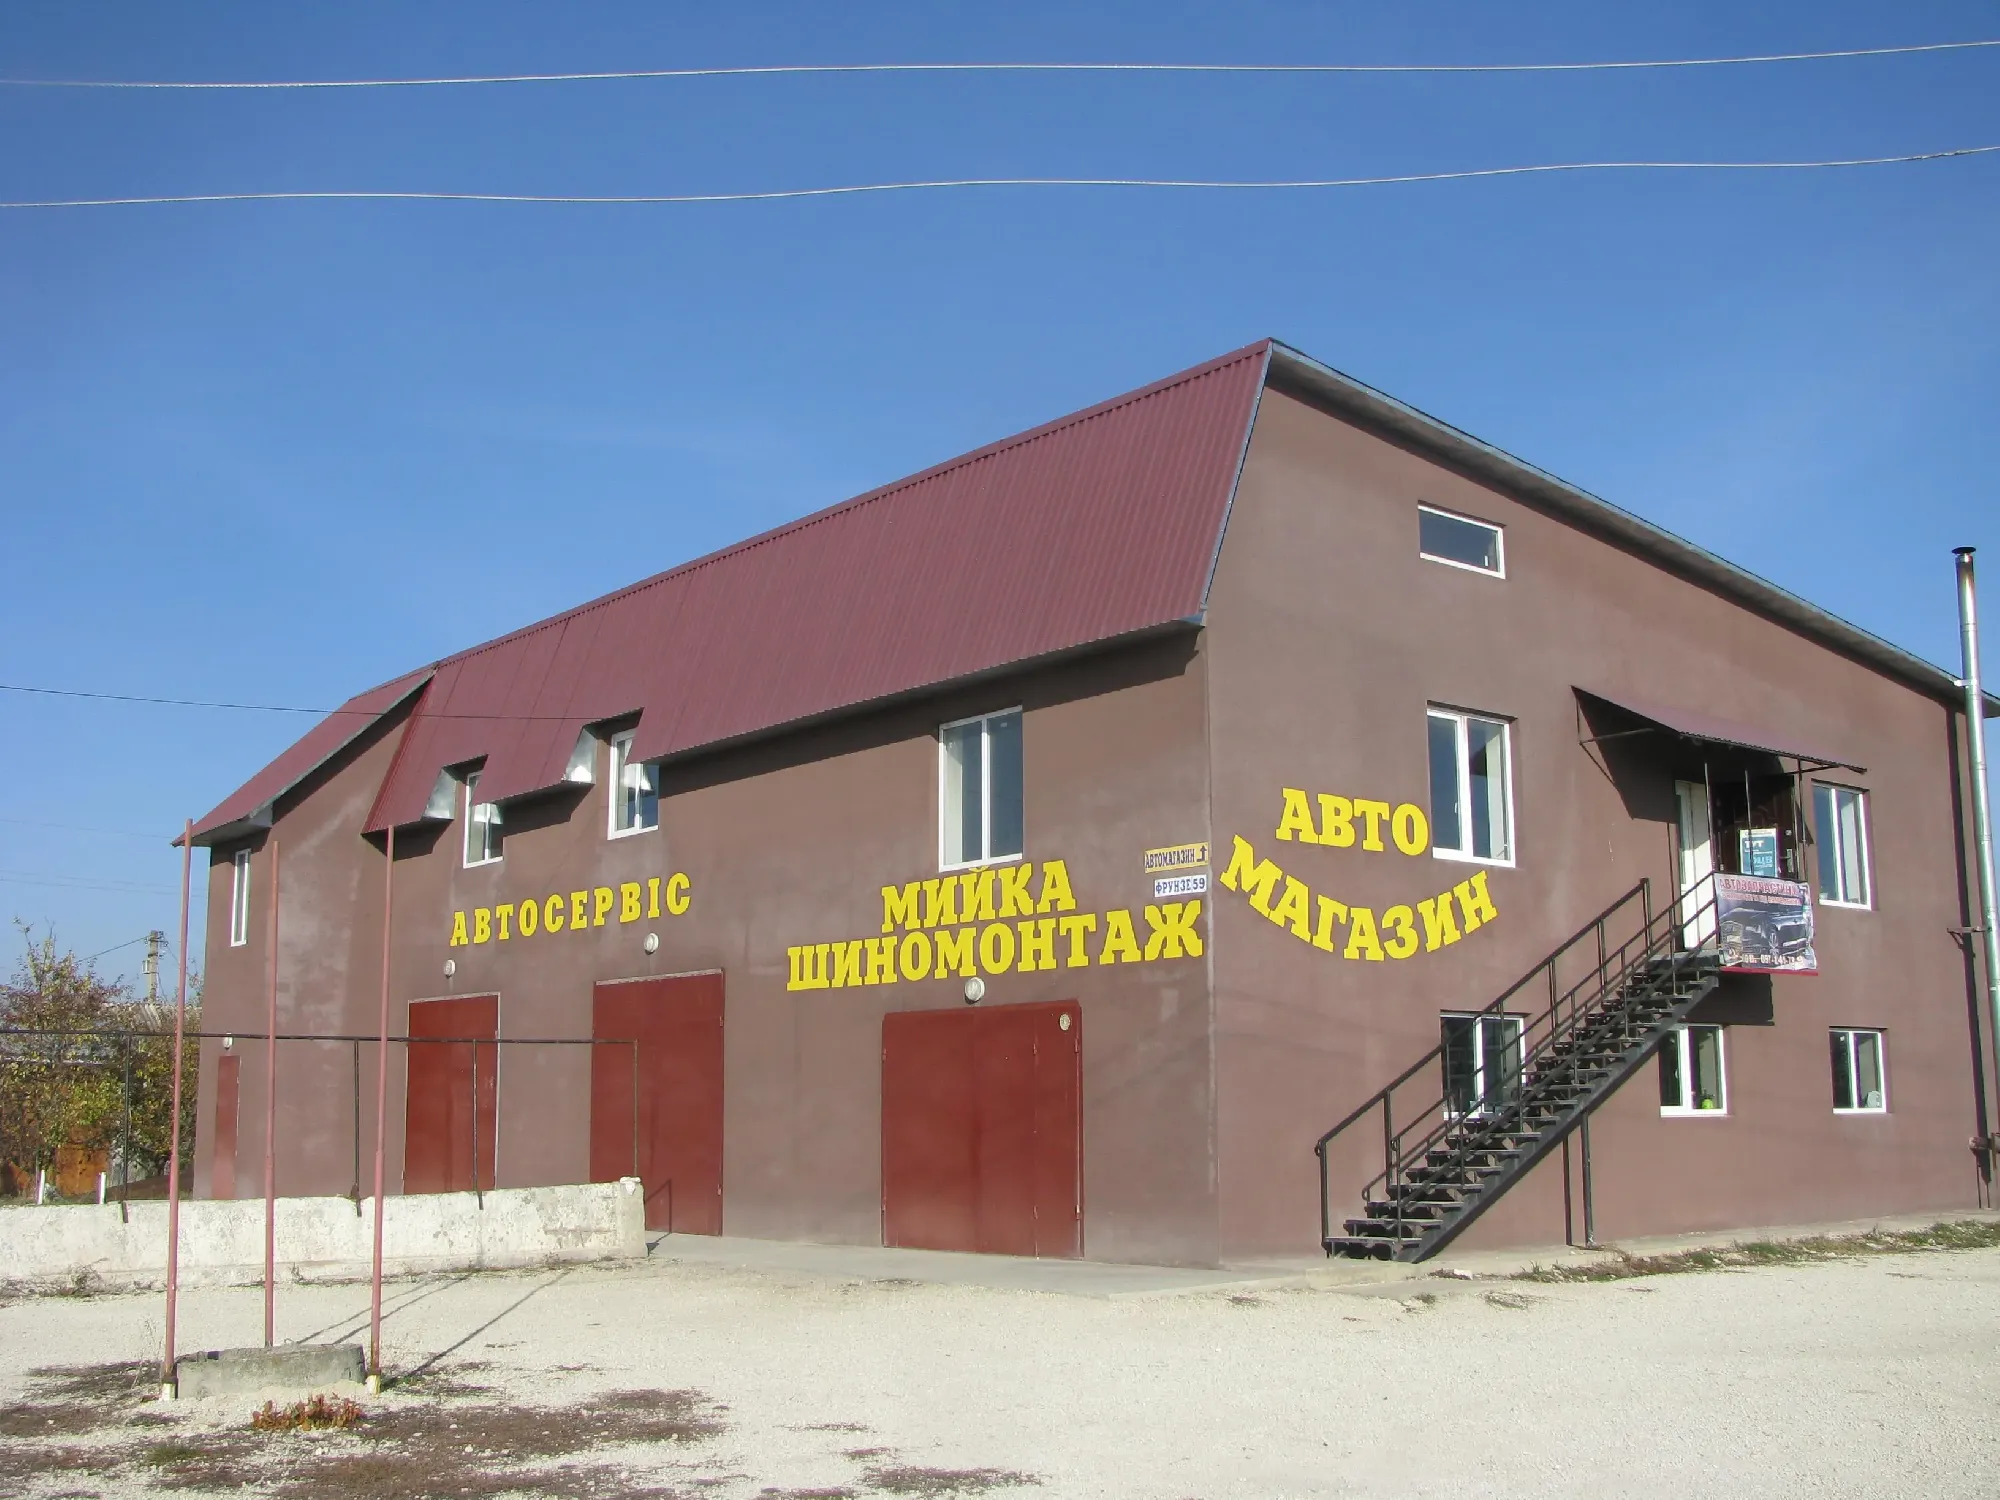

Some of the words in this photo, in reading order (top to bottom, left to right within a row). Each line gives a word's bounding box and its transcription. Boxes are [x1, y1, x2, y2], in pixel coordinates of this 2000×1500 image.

[1145, 848, 1195, 868] АВТОМАГАЗИН
[1275, 787, 1429, 857] АВТО
[449, 872, 692, 948] АВТОСЕРВІС
[881, 859, 1077, 934] МИЙКА
[1155, 879, 1191, 894] ФРУНЗЕ
[1192, 877, 1205, 890] 59
[1219, 834, 1499, 962] МАГАЗИН
[786, 899, 1203, 992] ШИНОМОНТАЖ
